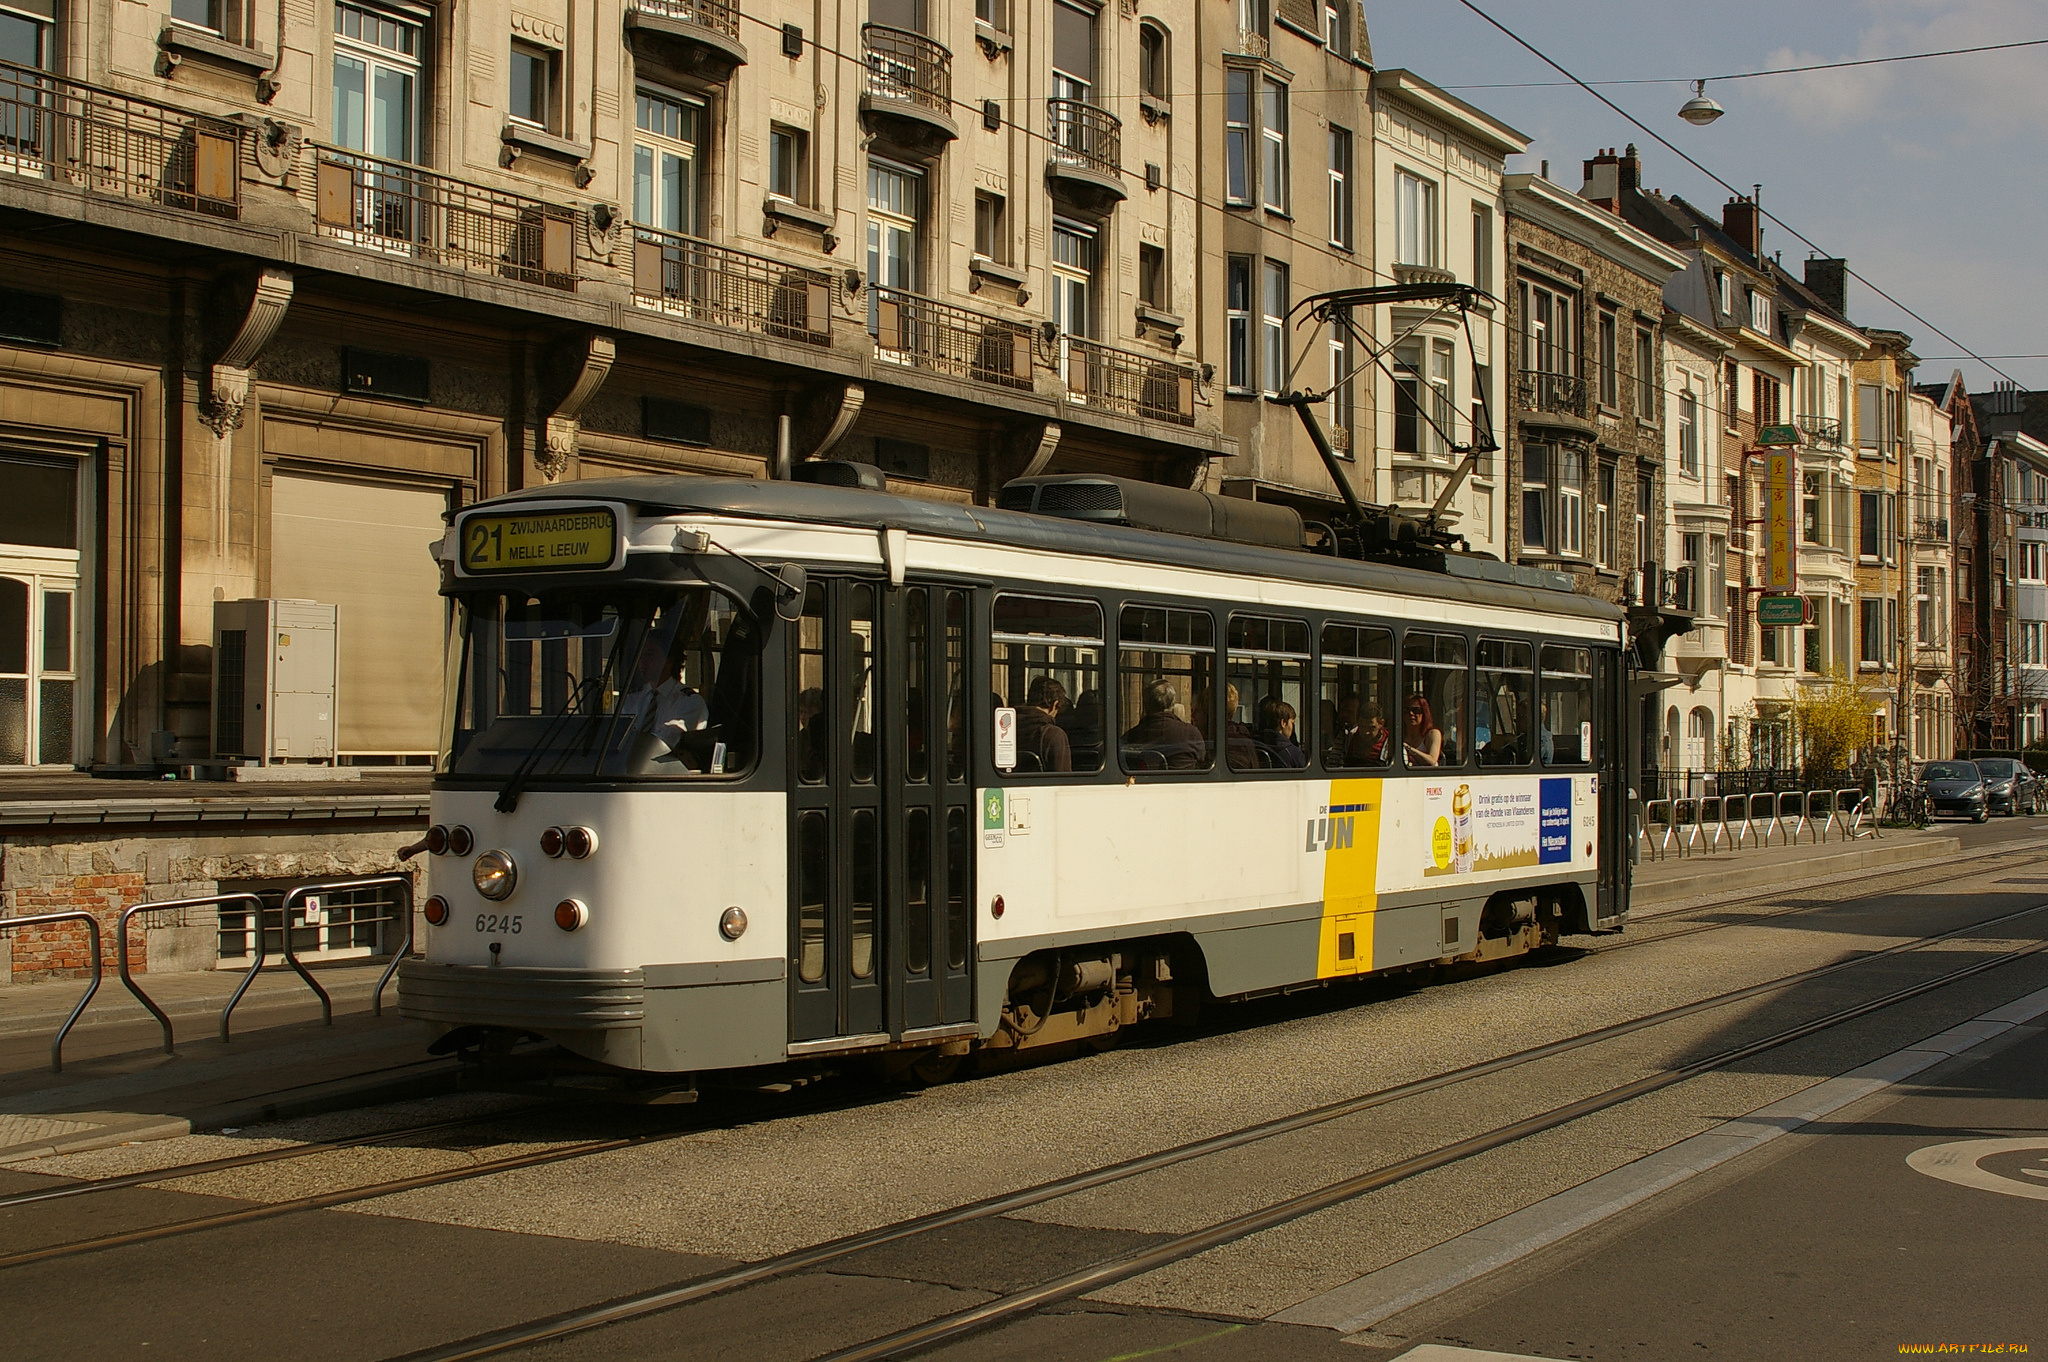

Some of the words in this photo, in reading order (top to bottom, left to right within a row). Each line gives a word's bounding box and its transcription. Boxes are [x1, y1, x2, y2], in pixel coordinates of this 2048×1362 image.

[509, 514, 612, 535] ZWIJNAARDEBRUG
[470, 524, 502, 563] 21
[509, 544, 545, 560] MELLE
[550, 541, 590, 557] LEEUW
[1479, 795, 1490, 804] Drink
[1491, 794, 1503, 805] gratis
[1504, 795, 1509, 804] op
[1510, 794, 1514, 802] de
[1515, 793, 1532, 802] winnaar
[1319, 805, 1327, 815] DE
[1484, 809, 1490, 817] de
[1491, 808, 1503, 818] Ronde
[1512, 807, 1535, 816] Vlaanderen
[1583, 816, 1595, 827] 6245
[1306, 816, 1354, 852] LIJN
[1435, 828, 1451, 841] Gratis
[475, 913, 523, 935] 6245
